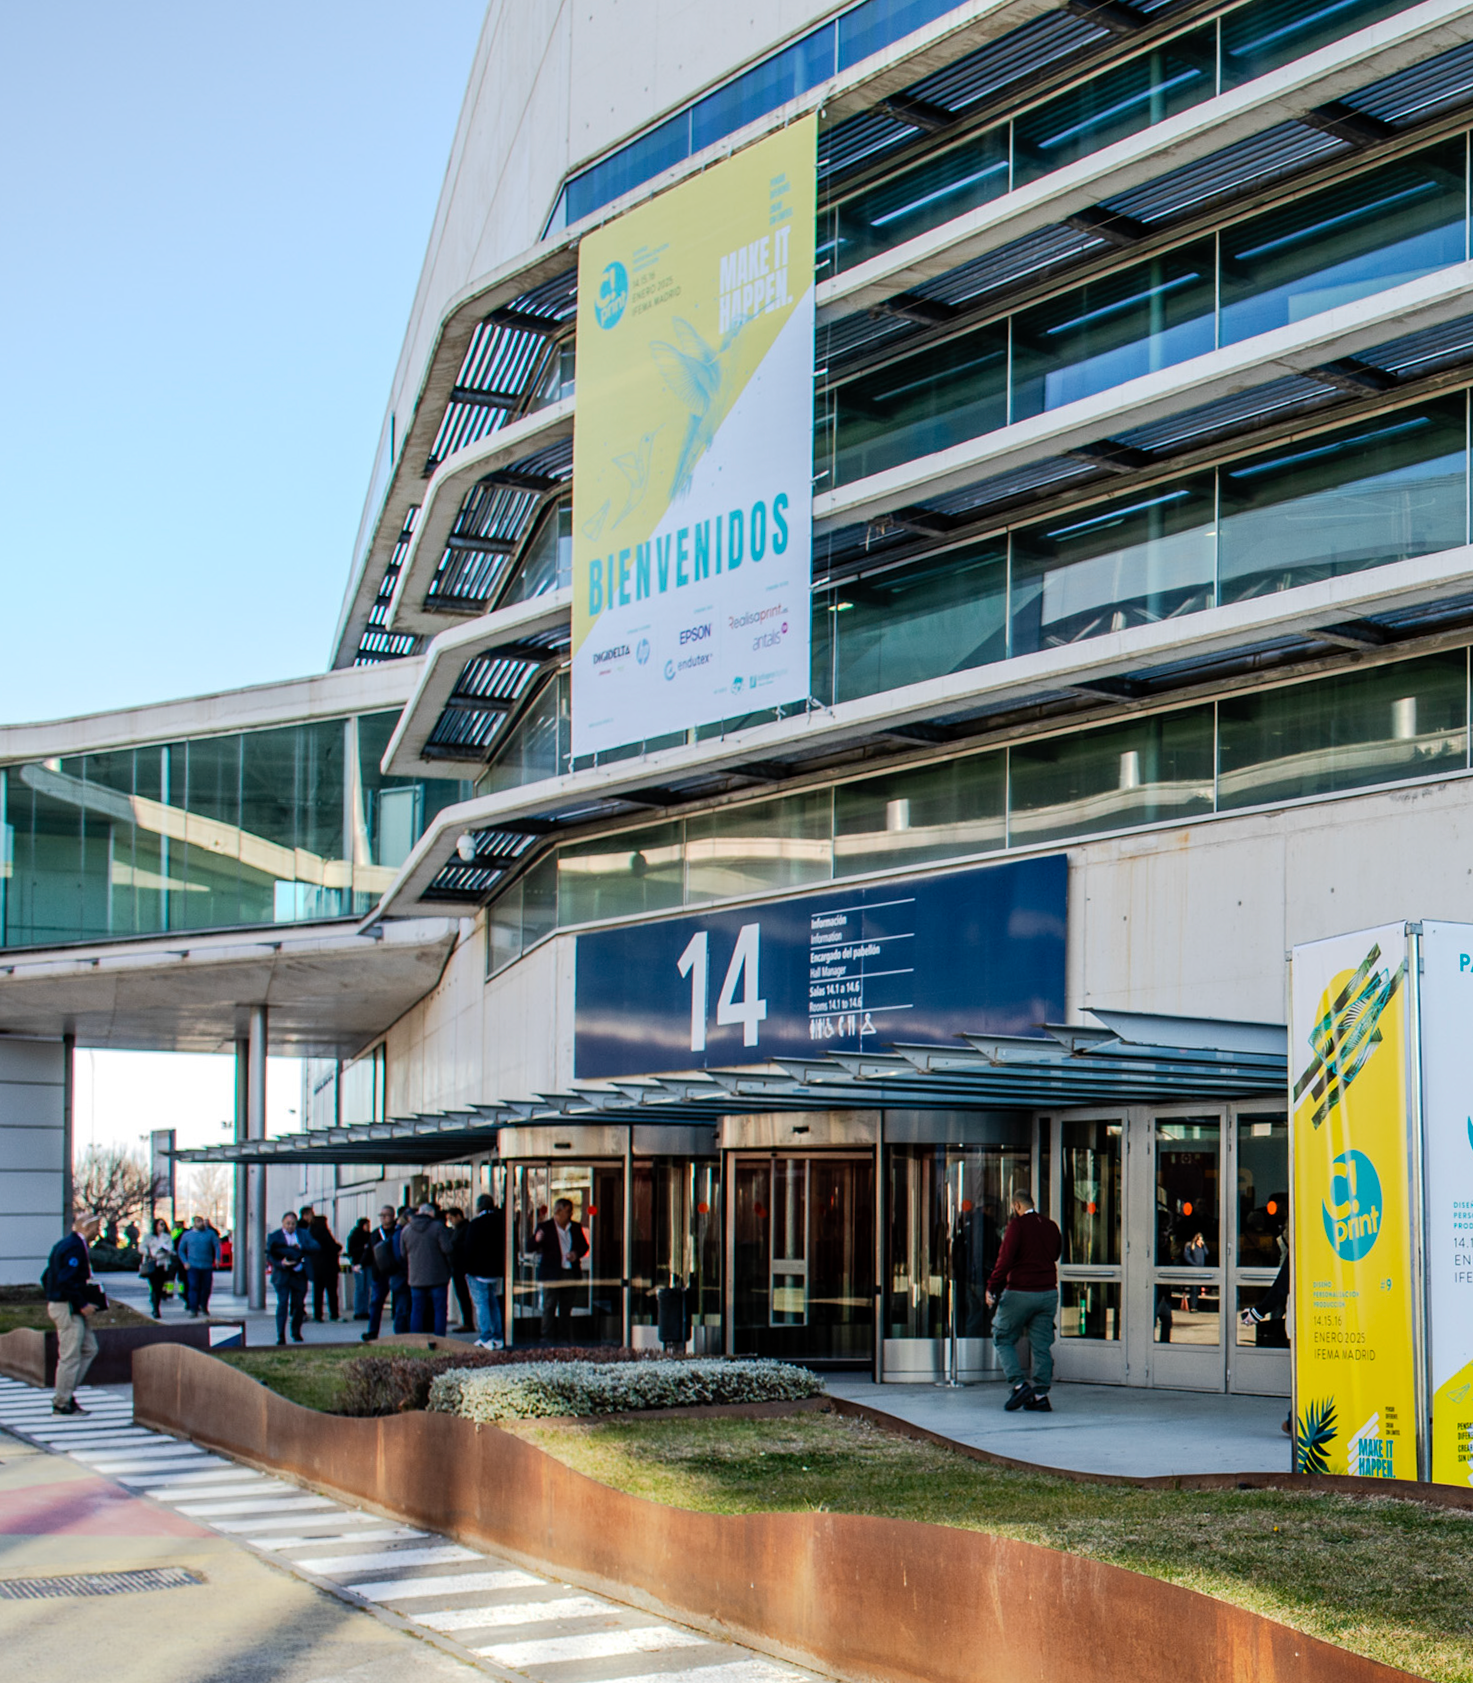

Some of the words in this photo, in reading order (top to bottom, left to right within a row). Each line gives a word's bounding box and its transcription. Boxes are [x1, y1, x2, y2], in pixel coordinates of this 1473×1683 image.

[719, 236, 770, 295] MAKE
[774, 225, 791, 270] IT
[718, 267, 793, 335] HAPPEN.
[588, 492, 789, 617] BIENVENIDOS
[679, 622, 713, 646] EPSON
[811, 914, 847, 930] Información
[810, 931, 842, 945] Information
[810, 949, 842, 964] Encargado
[842, 947, 853, 959] del
[853, 944, 881, 961] pabellón
[809, 967, 821, 979] Hall
[821, 966, 847, 978] Manager
[676, 922, 767, 1052] 14
[809, 985, 826, 998] Salas
[826, 983, 840, 995] 14.1
[840, 984, 845, 994] a
[846, 981, 860, 993] 14.6
[809, 1001, 828, 1012] Rooms
[828, 999, 841, 1010] 14.1
[841, 998, 849, 1009] to
[849, 996, 863, 1008] 14.6
[1334, 1205, 1380, 1251] print
[1313, 1315, 1342, 1326] 14.15.16
[1314, 1332, 1343, 1343] ENERO
[1345, 1333, 1366, 1344] 2025
[1314, 1348, 1340, 1360] IFEMA
[1342, 1349, 1376, 1361] MADRID
[1358, 1438, 1383, 1458] MAKE
[1386, 1440, 1394, 1458] IT
[1457, 1444, 1473, 1453] CREAR
[1457, 1454, 1467, 1463] SIN
[1358, 1457, 1396, 1479] HAPPEN.
